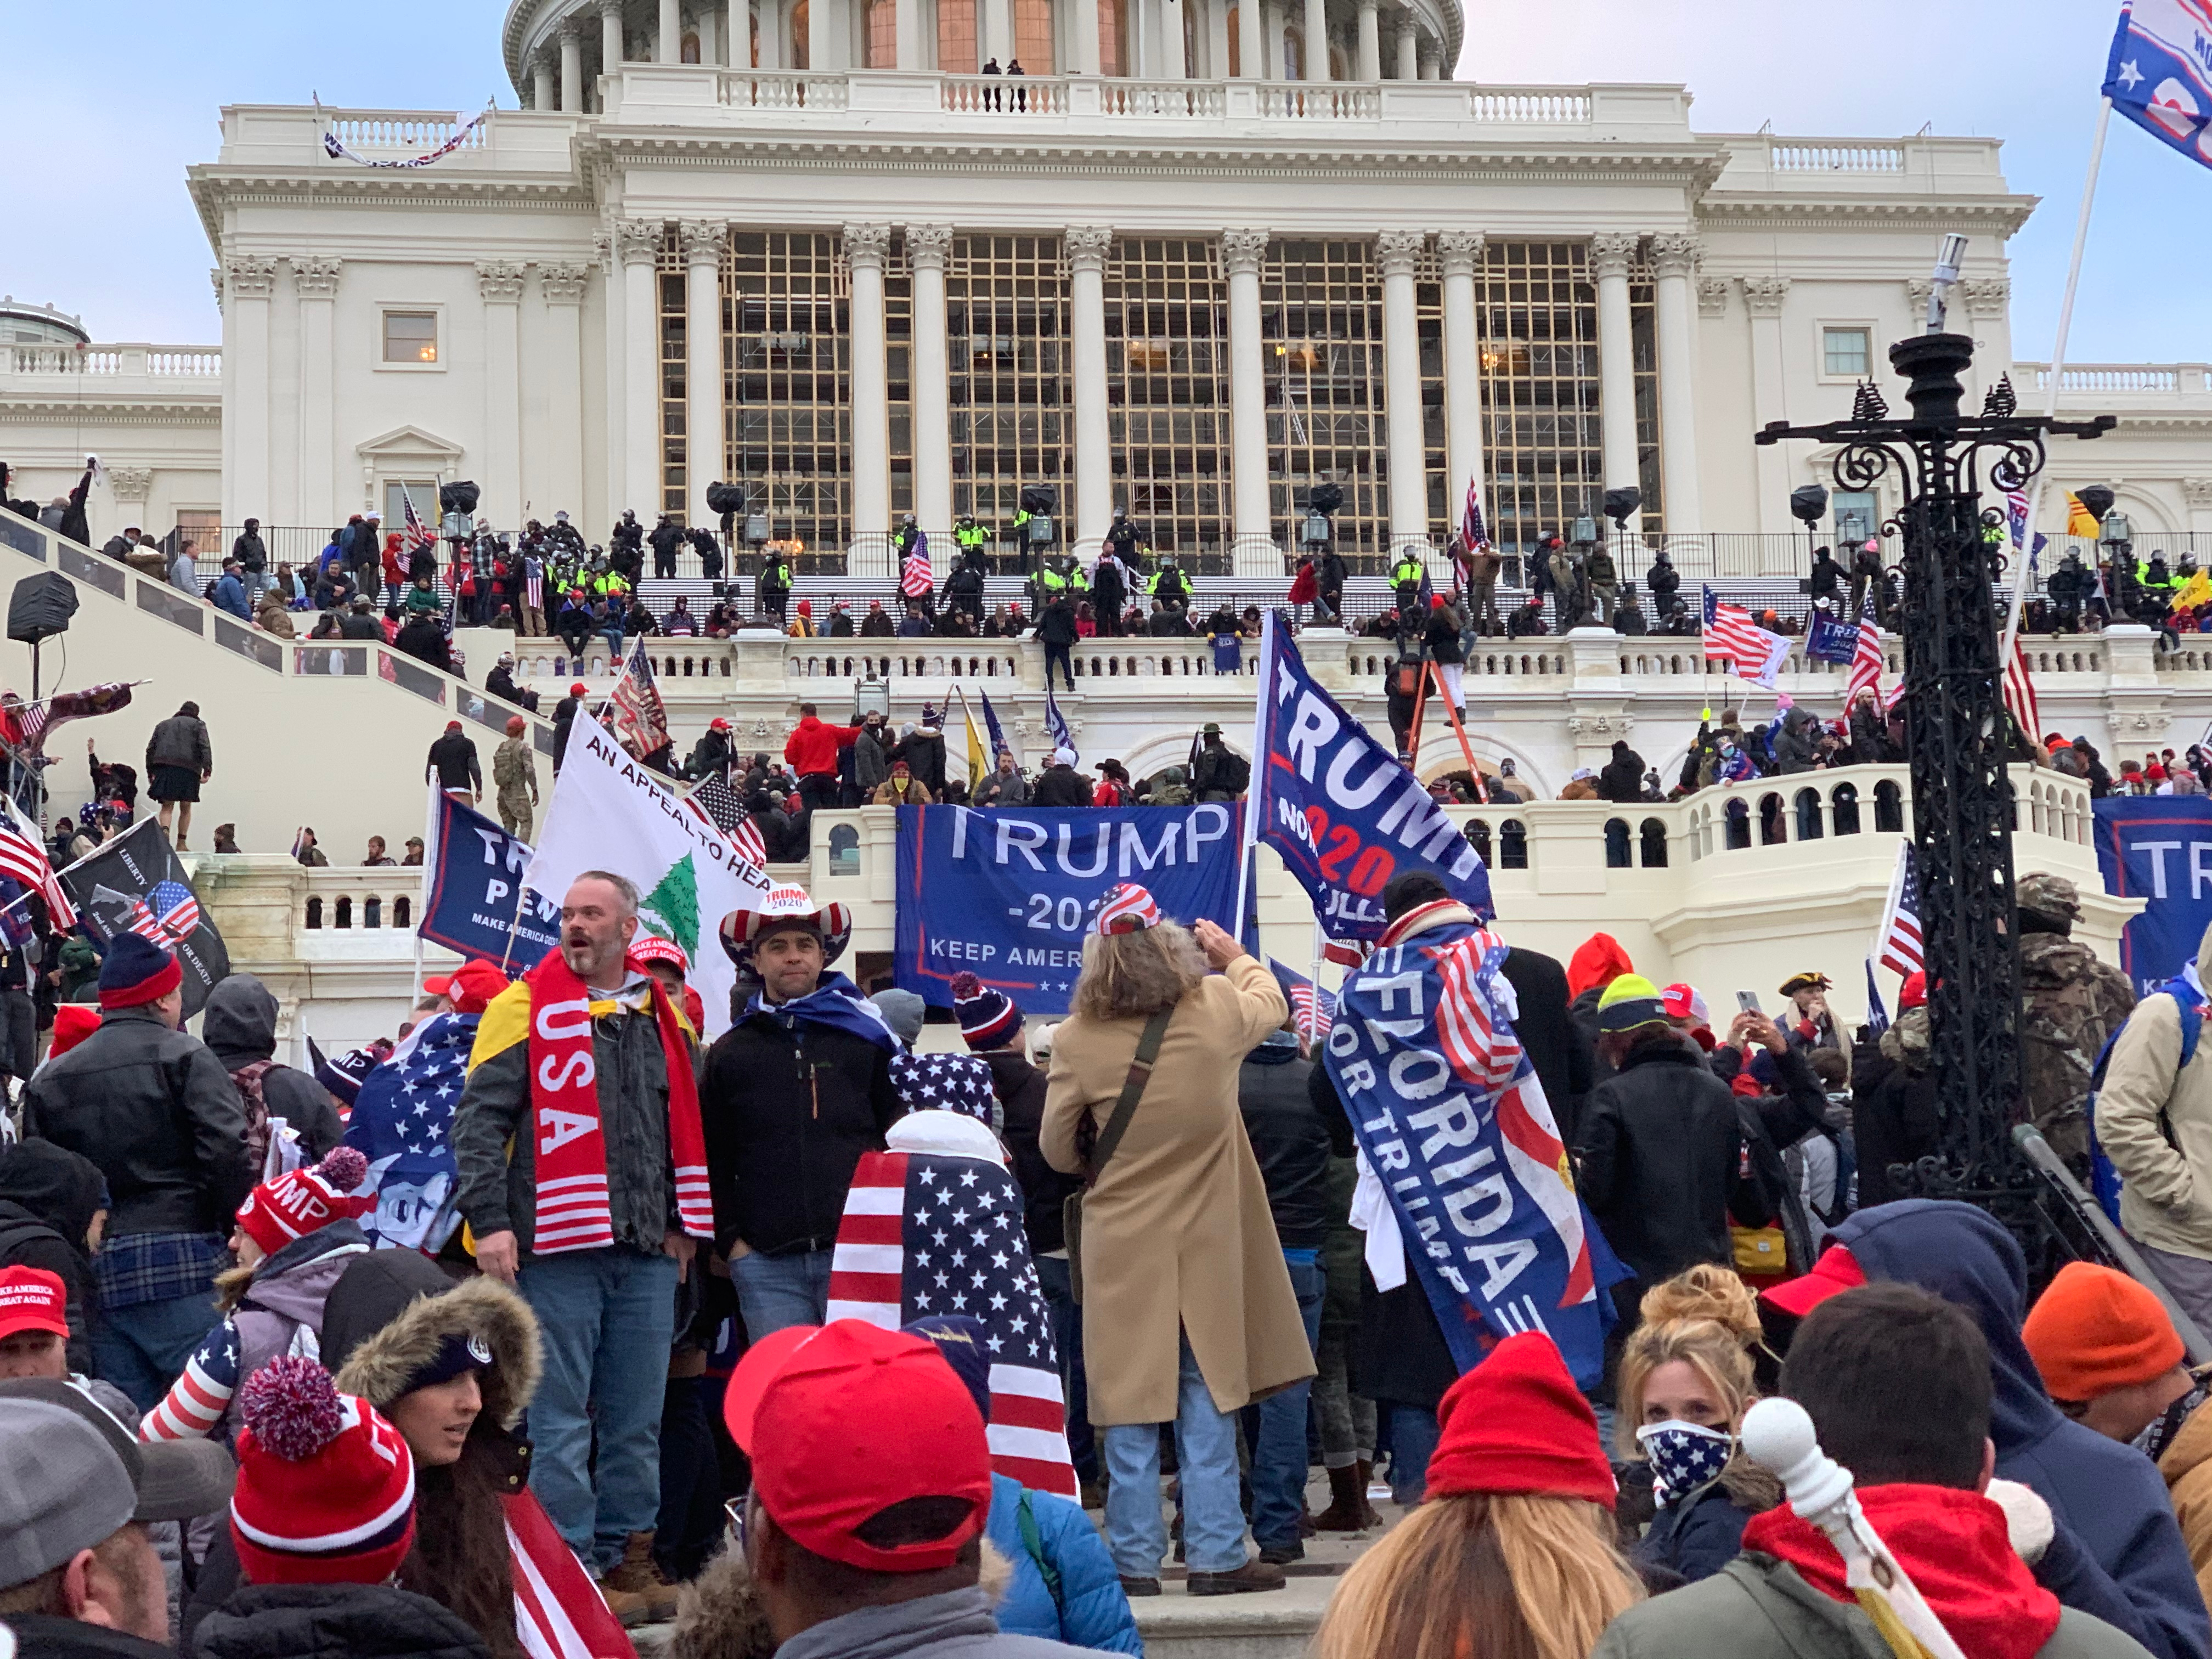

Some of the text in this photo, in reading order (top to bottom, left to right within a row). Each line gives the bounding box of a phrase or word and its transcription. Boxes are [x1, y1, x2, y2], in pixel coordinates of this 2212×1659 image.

[586, 735, 617, 767] AN
[620, 763, 695, 837] APPEAL
[698, 831, 722, 860] TO
[949, 804, 1229, 878] TRUMP
[119, 849, 147, 886] LIBERTY
[485, 878, 562, 927] PEN
[766, 889, 808, 904] TRUMP
[772, 899, 803, 910] 2020
[472, 913, 505, 931] MAKE
[506, 923, 544, 943] AMERICA
[630, 940, 684, 957] MAKE AMERICA
[658, 950, 680, 964] AGAIN
[932, 939, 996, 962] KEEP
[182, 944, 212, 986] OR DEATH
[535, 997, 599, 1156] USA
[1355, 970, 1539, 1303] FLORIDA
[14, 1285, 55, 1295] AMERICA
[23, 1296, 50, 1305] AGAIN
